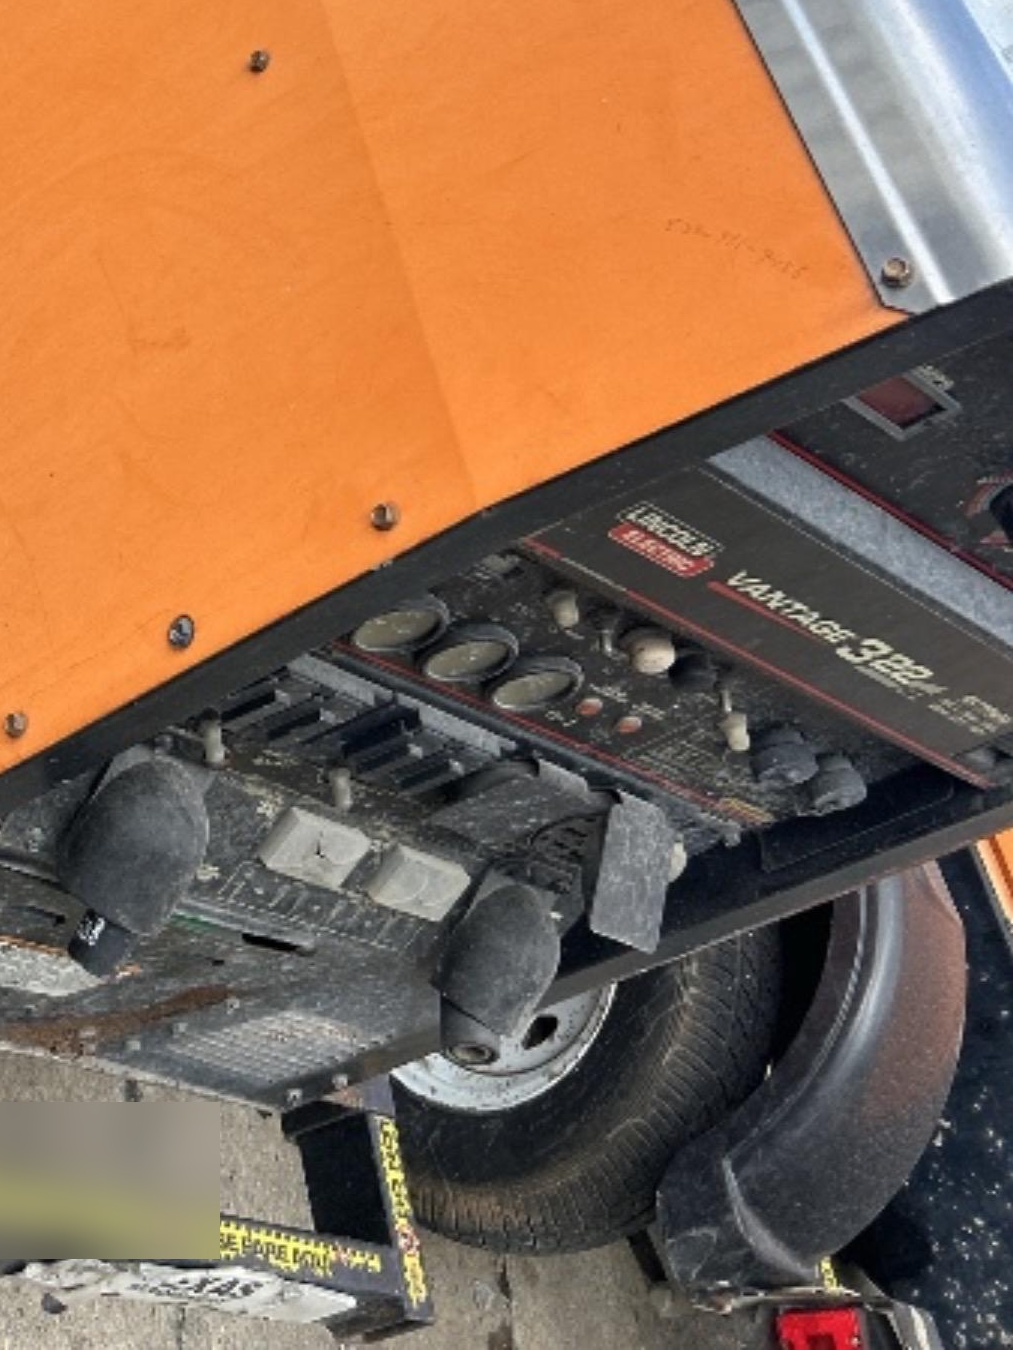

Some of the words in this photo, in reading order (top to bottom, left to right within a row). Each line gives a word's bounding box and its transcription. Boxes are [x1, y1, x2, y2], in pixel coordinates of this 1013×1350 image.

[621, 530, 694, 573] ELECTRIC
[626, 506, 715, 558] LINCOLN
[726, 569, 857, 645] VANTAGE
[835, 636, 934, 687] 322
